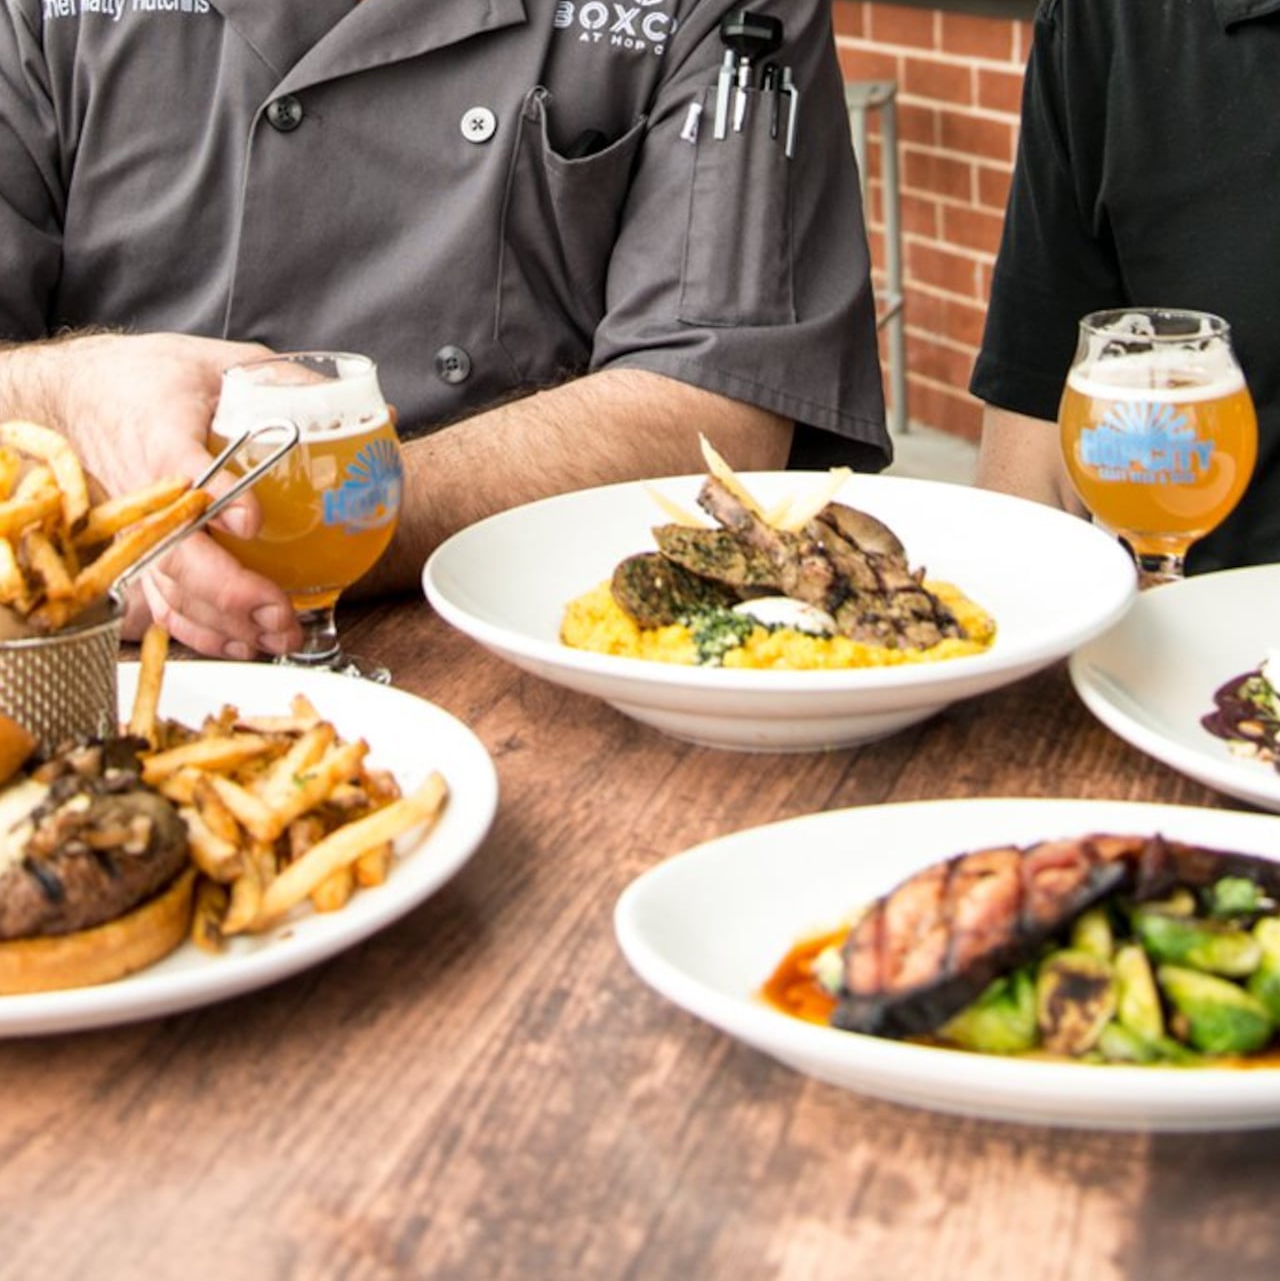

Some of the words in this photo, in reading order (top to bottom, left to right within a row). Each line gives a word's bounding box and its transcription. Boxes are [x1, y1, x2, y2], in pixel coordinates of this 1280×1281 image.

[554, 0, 678, 42] BOXC
[579, 31, 603, 43] AT
[611, 35, 646, 50] HOP
